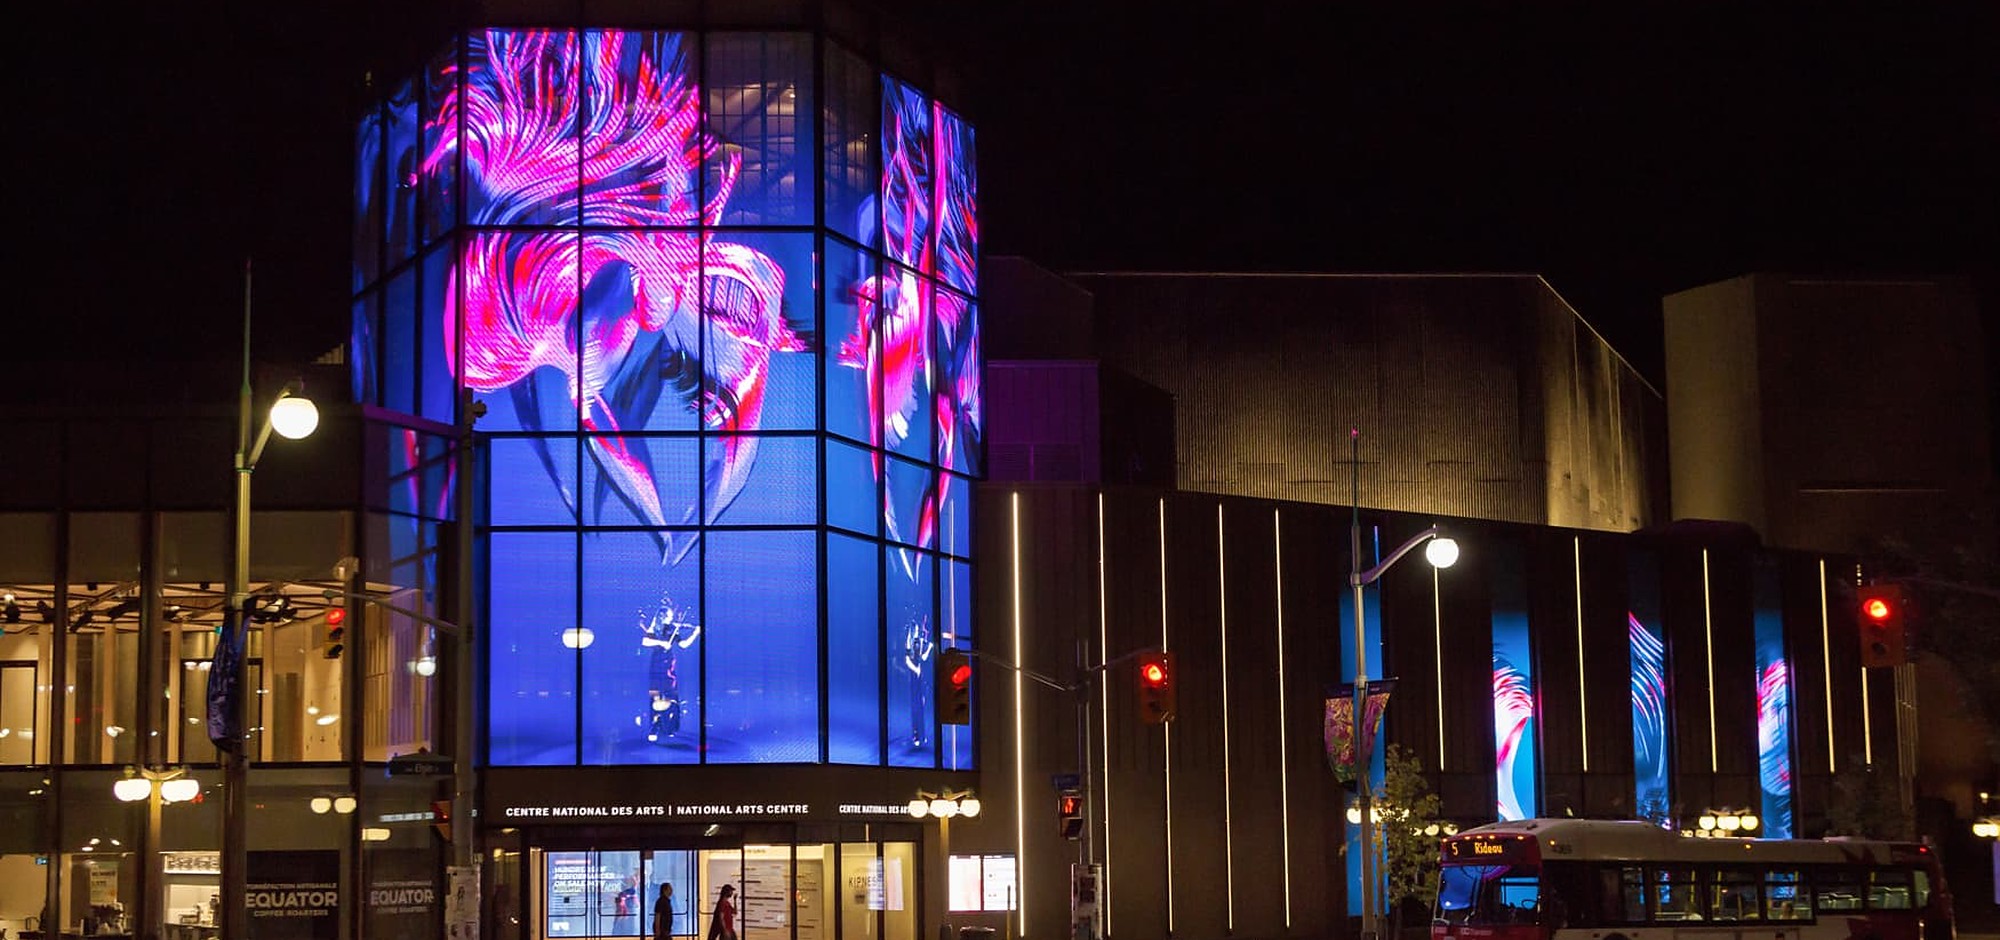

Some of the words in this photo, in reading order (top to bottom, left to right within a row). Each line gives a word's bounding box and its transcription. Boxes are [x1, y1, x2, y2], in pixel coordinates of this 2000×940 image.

[506, 807, 549, 817] CENTRE
[552, 807, 608, 816] NATIONAL
[611, 806, 632, 816] DES
[635, 805, 664, 816] ARTS
[677, 805, 733, 815] NATIONAL
[735, 805, 763, 815] ARTS
[766, 804, 808, 814] CENTRE
[839, 804, 861, 814] CENTRE
[1451, 842, 1459, 856] 5
[1474, 842, 1503, 854] Rideau
[245, 892, 338, 908] EQUATOR
[370, 889, 433, 906] EQUATOR
